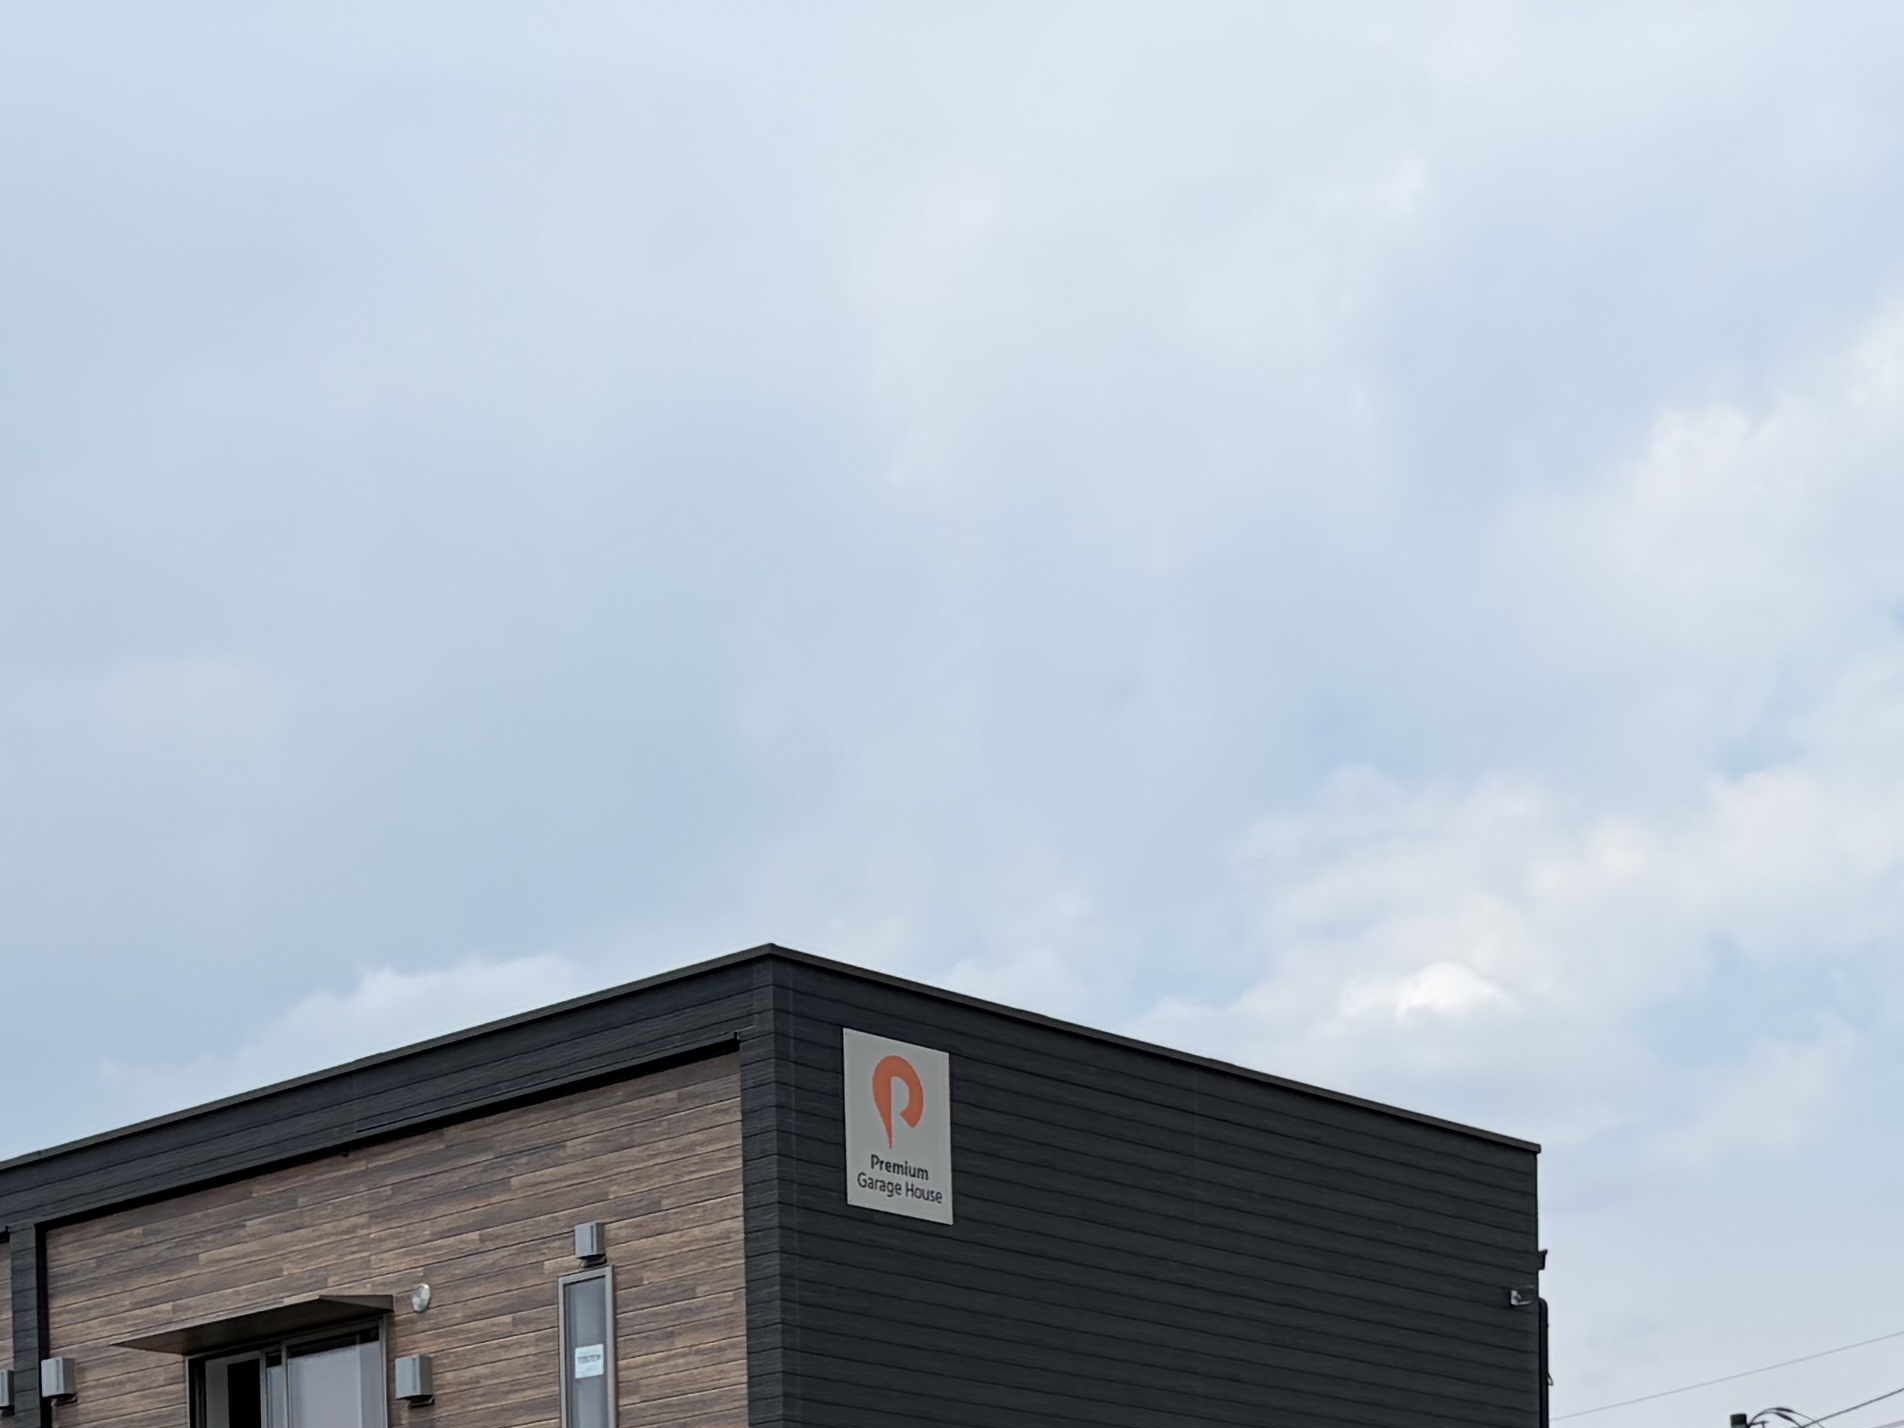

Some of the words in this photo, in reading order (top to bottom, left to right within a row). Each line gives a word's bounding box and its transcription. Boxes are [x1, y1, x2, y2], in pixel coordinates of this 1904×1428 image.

[870, 1154, 929, 1181] Premium
[857, 1172, 902, 1198] Garage
[905, 1182, 943, 1204] House
